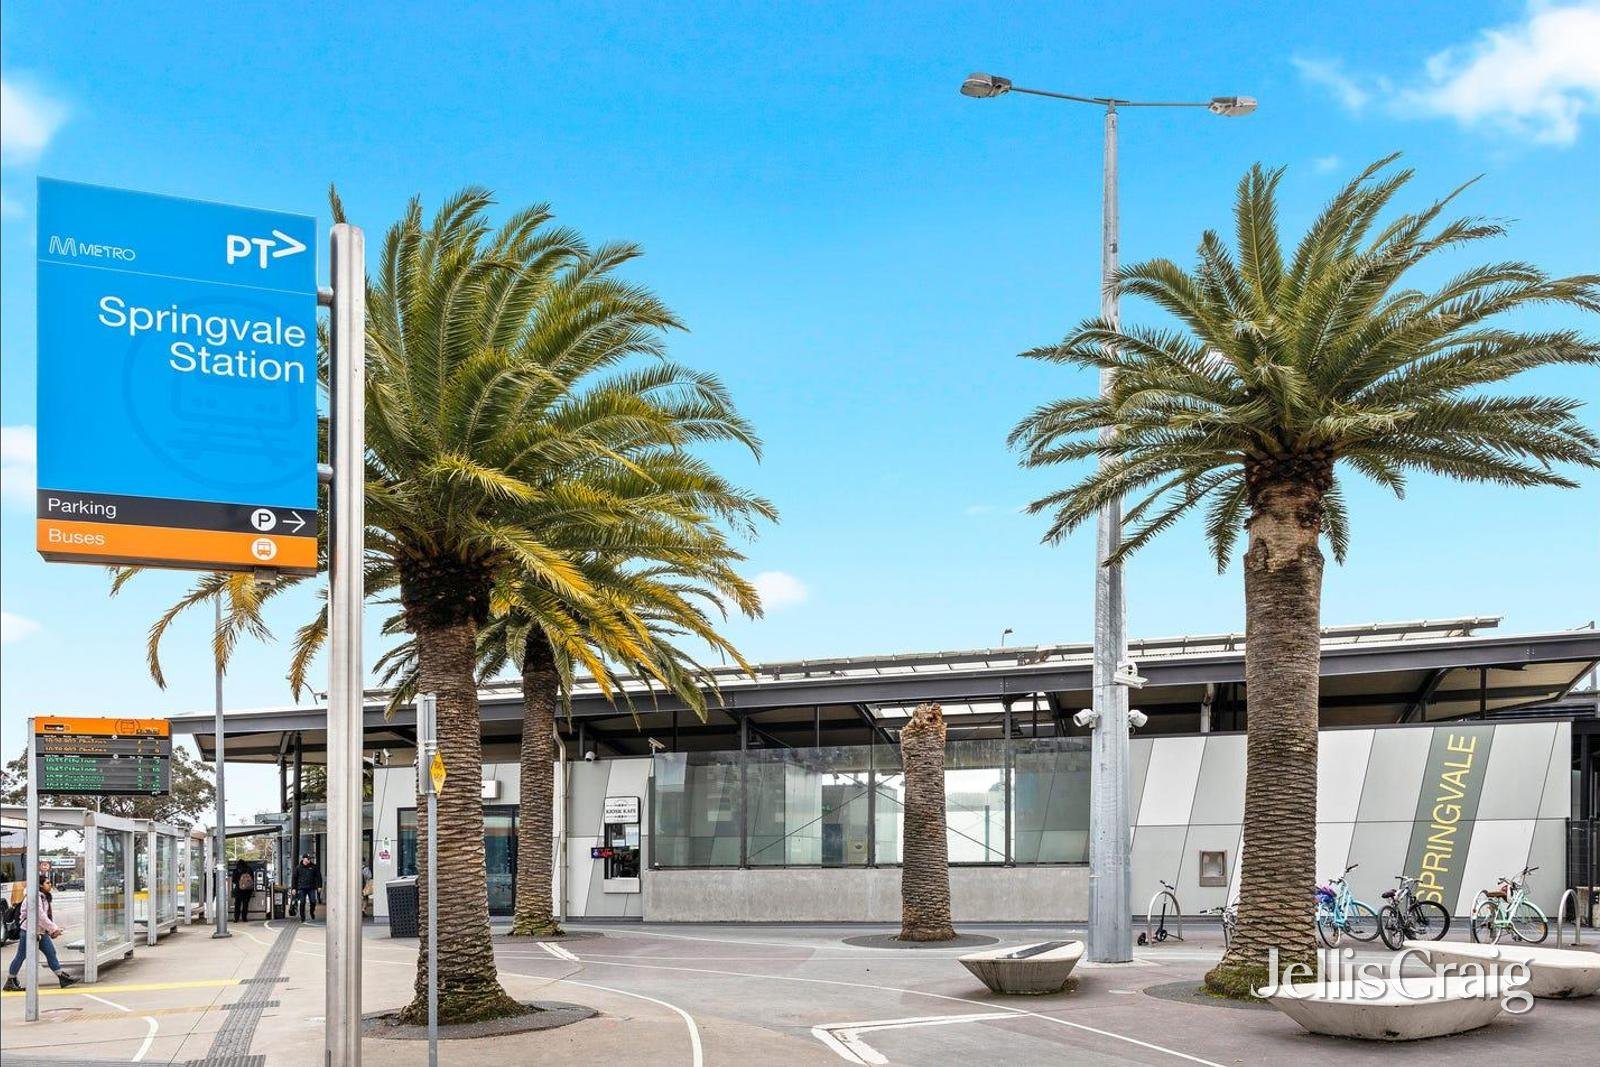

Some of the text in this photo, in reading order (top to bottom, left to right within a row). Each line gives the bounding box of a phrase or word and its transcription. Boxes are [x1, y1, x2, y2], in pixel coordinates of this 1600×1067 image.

[79, 242, 136, 261] METRO
[98, 295, 306, 348] Springvale
[169, 341, 305, 384] Station
[47, 497, 117, 519] Parking
[47, 527, 106, 546] Buses
[1416, 733, 1477, 908] SPRINGVALE
